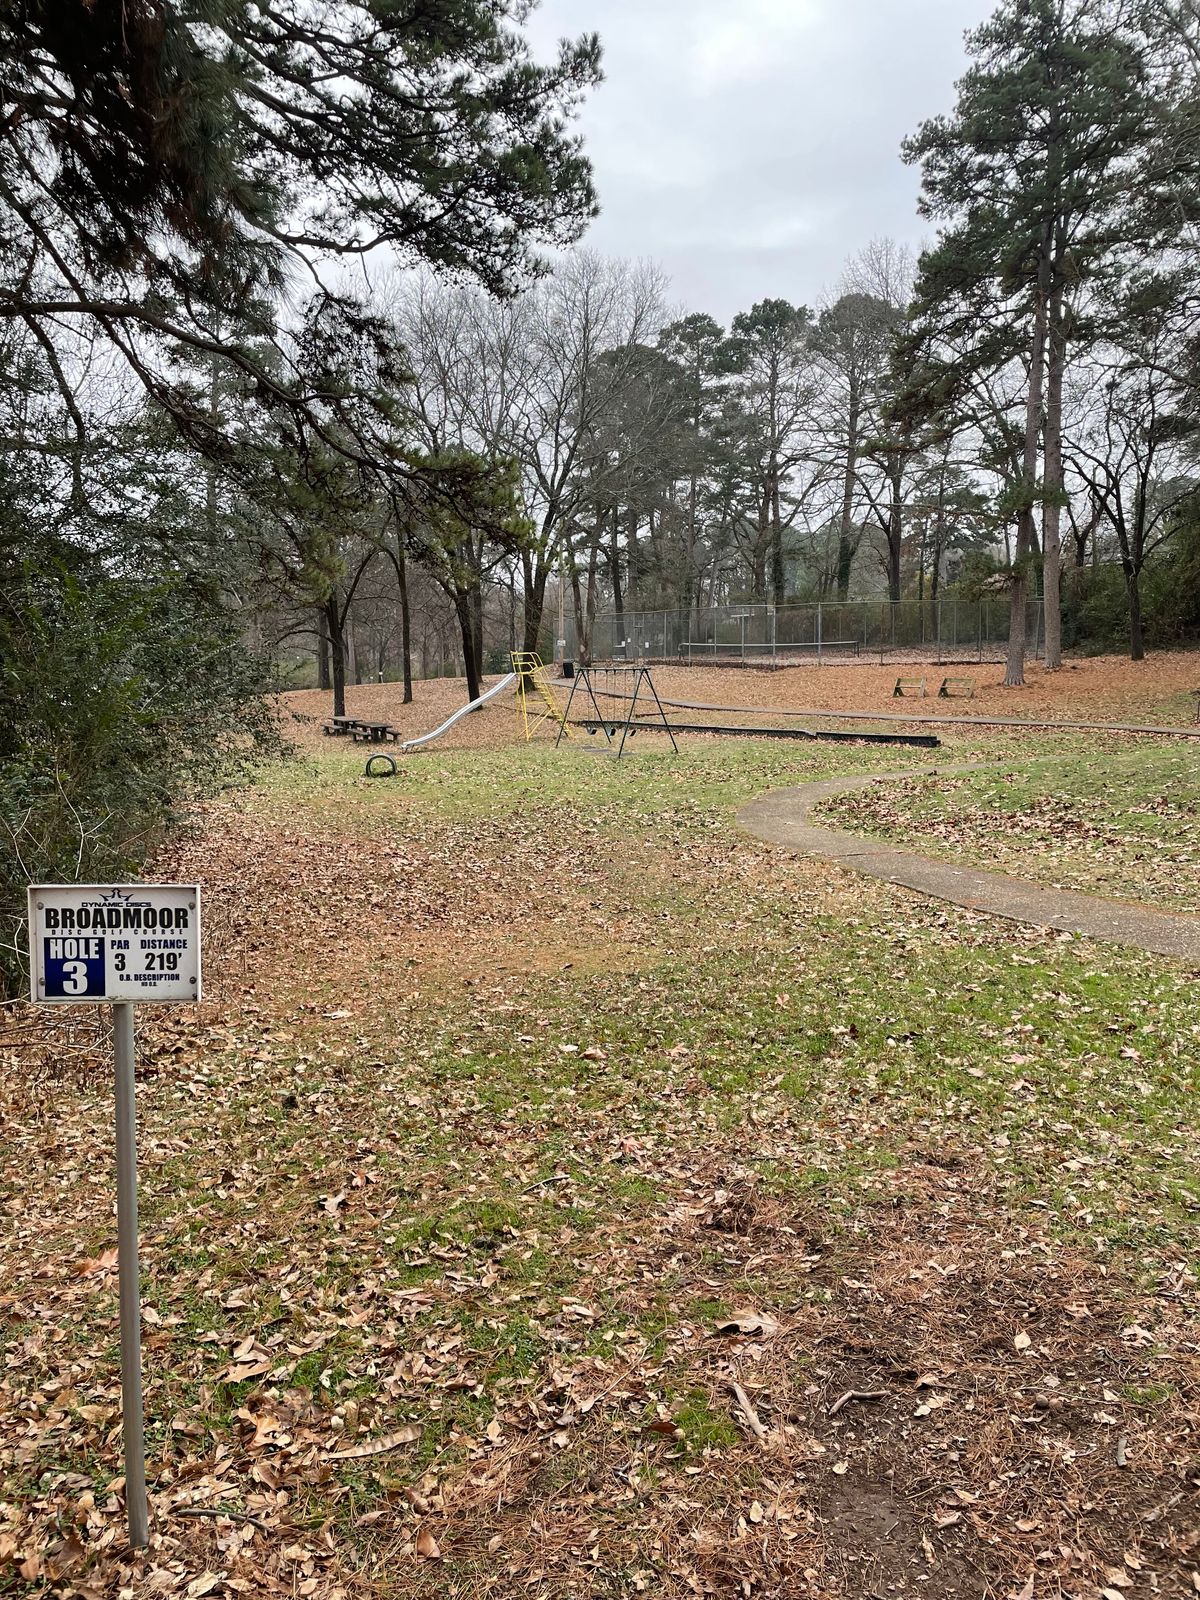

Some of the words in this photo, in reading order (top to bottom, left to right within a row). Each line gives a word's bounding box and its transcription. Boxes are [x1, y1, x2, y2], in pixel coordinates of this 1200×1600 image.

[45, 907, 189, 929] BROADMOOR
[49, 938, 100, 960] HOLE
[110, 940, 130, 949] PAR
[140, 939, 188, 949] DISTANCE
[114, 953, 126, 971] 3
[144, 952, 182, 971] 219'
[62, 960, 88, 995] 3
